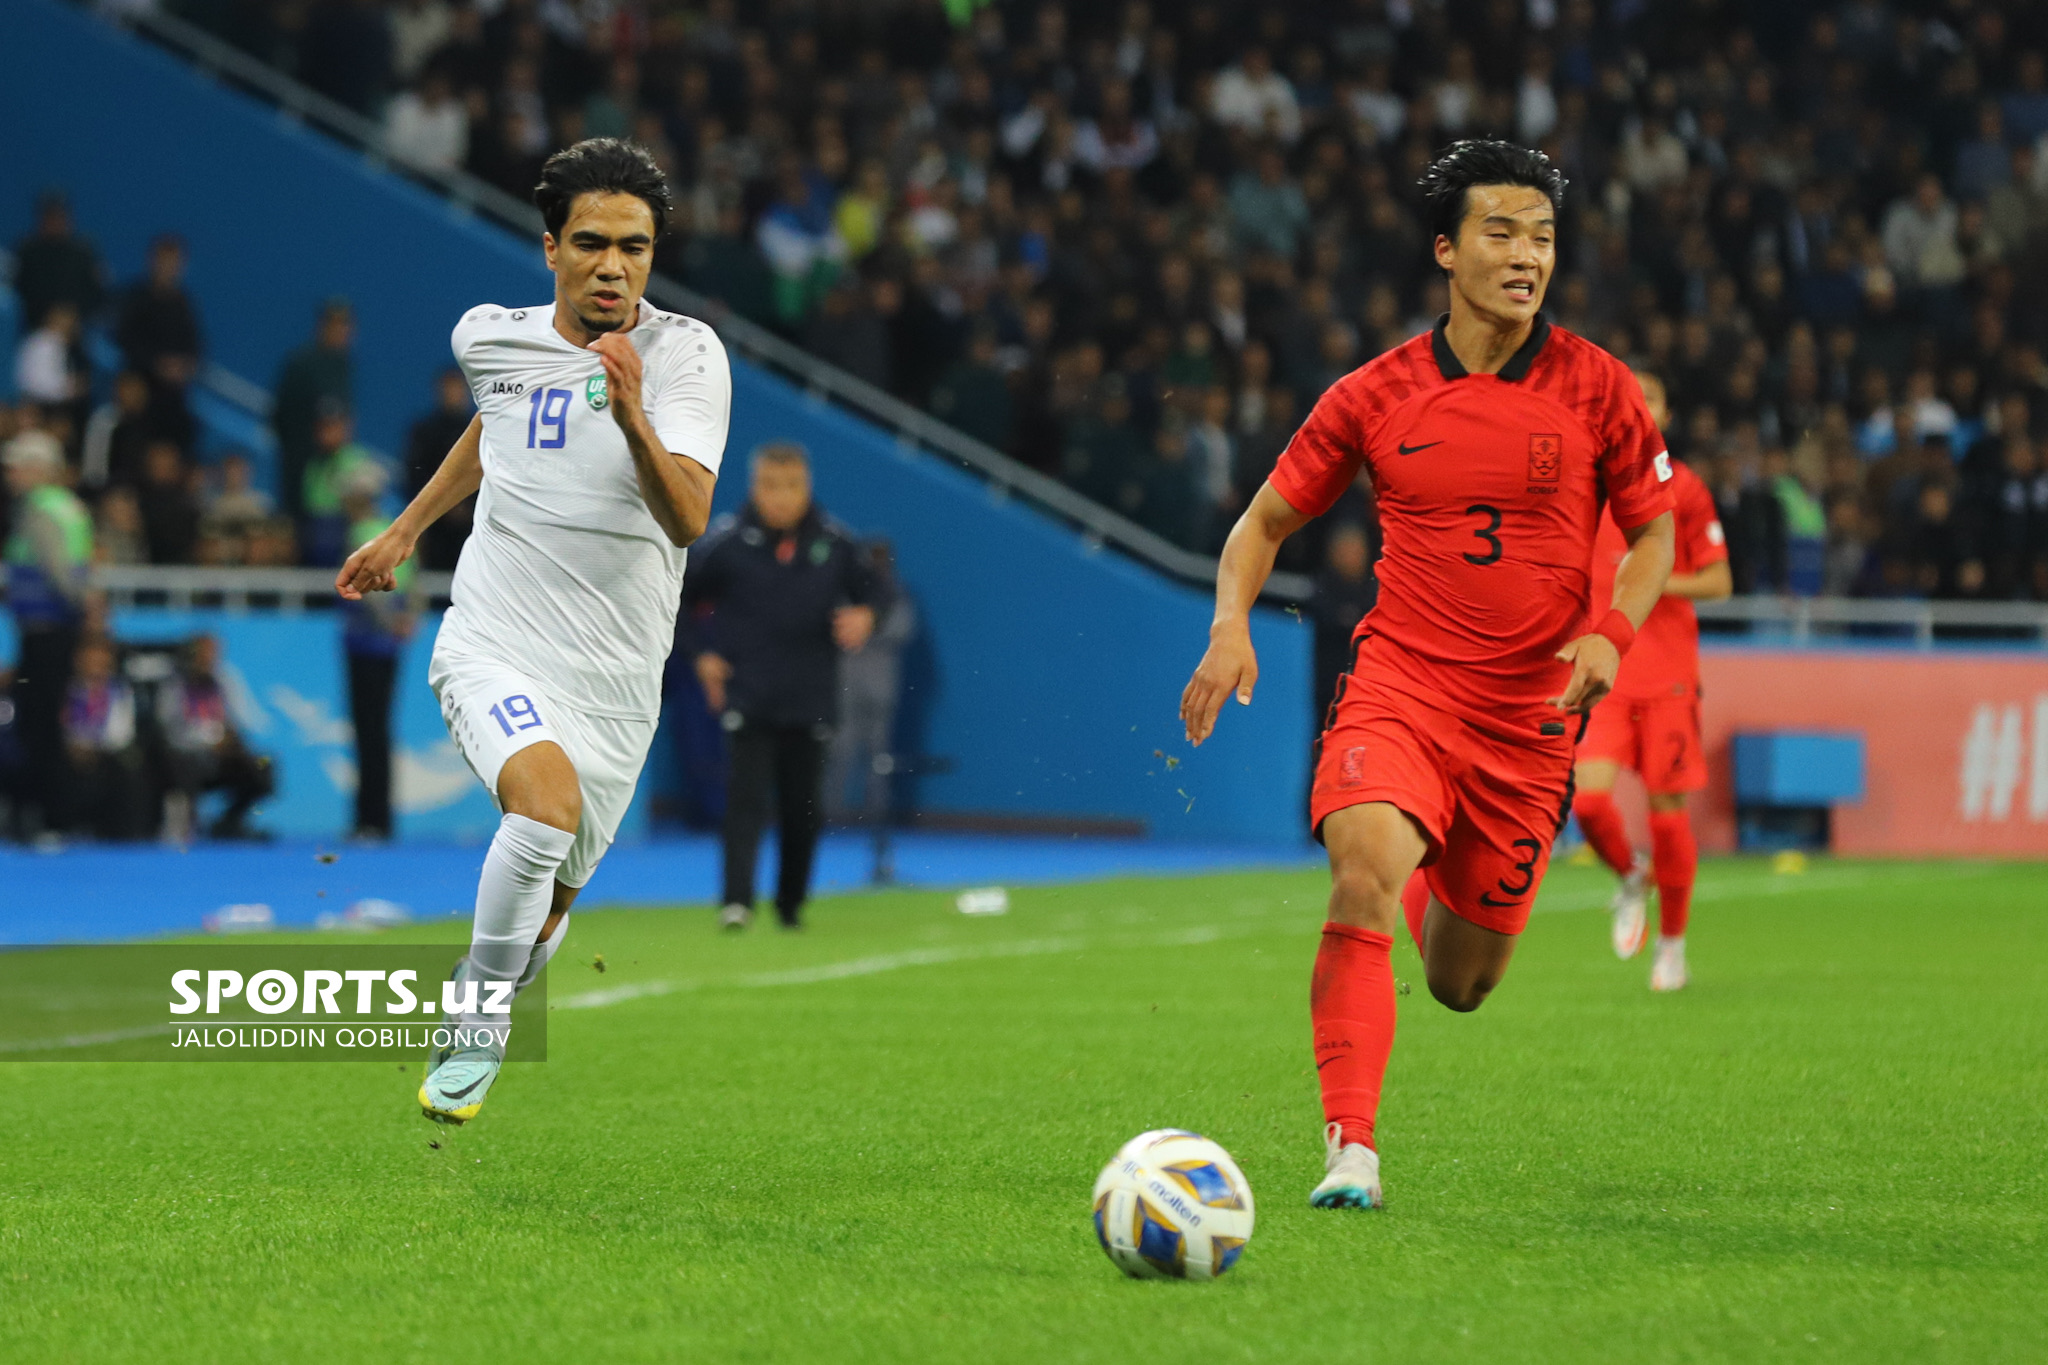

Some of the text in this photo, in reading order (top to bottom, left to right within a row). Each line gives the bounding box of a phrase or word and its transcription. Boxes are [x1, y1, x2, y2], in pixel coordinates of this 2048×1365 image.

[492, 382, 524, 395] JAKO
[589, 379, 607, 393] UF
[526, 387, 573, 449] 19
[1463, 504, 1503, 566] 3
[489, 694, 544, 738] 19
[1498, 838, 1541, 896] 3
[1149, 1180, 1202, 1229] molten
